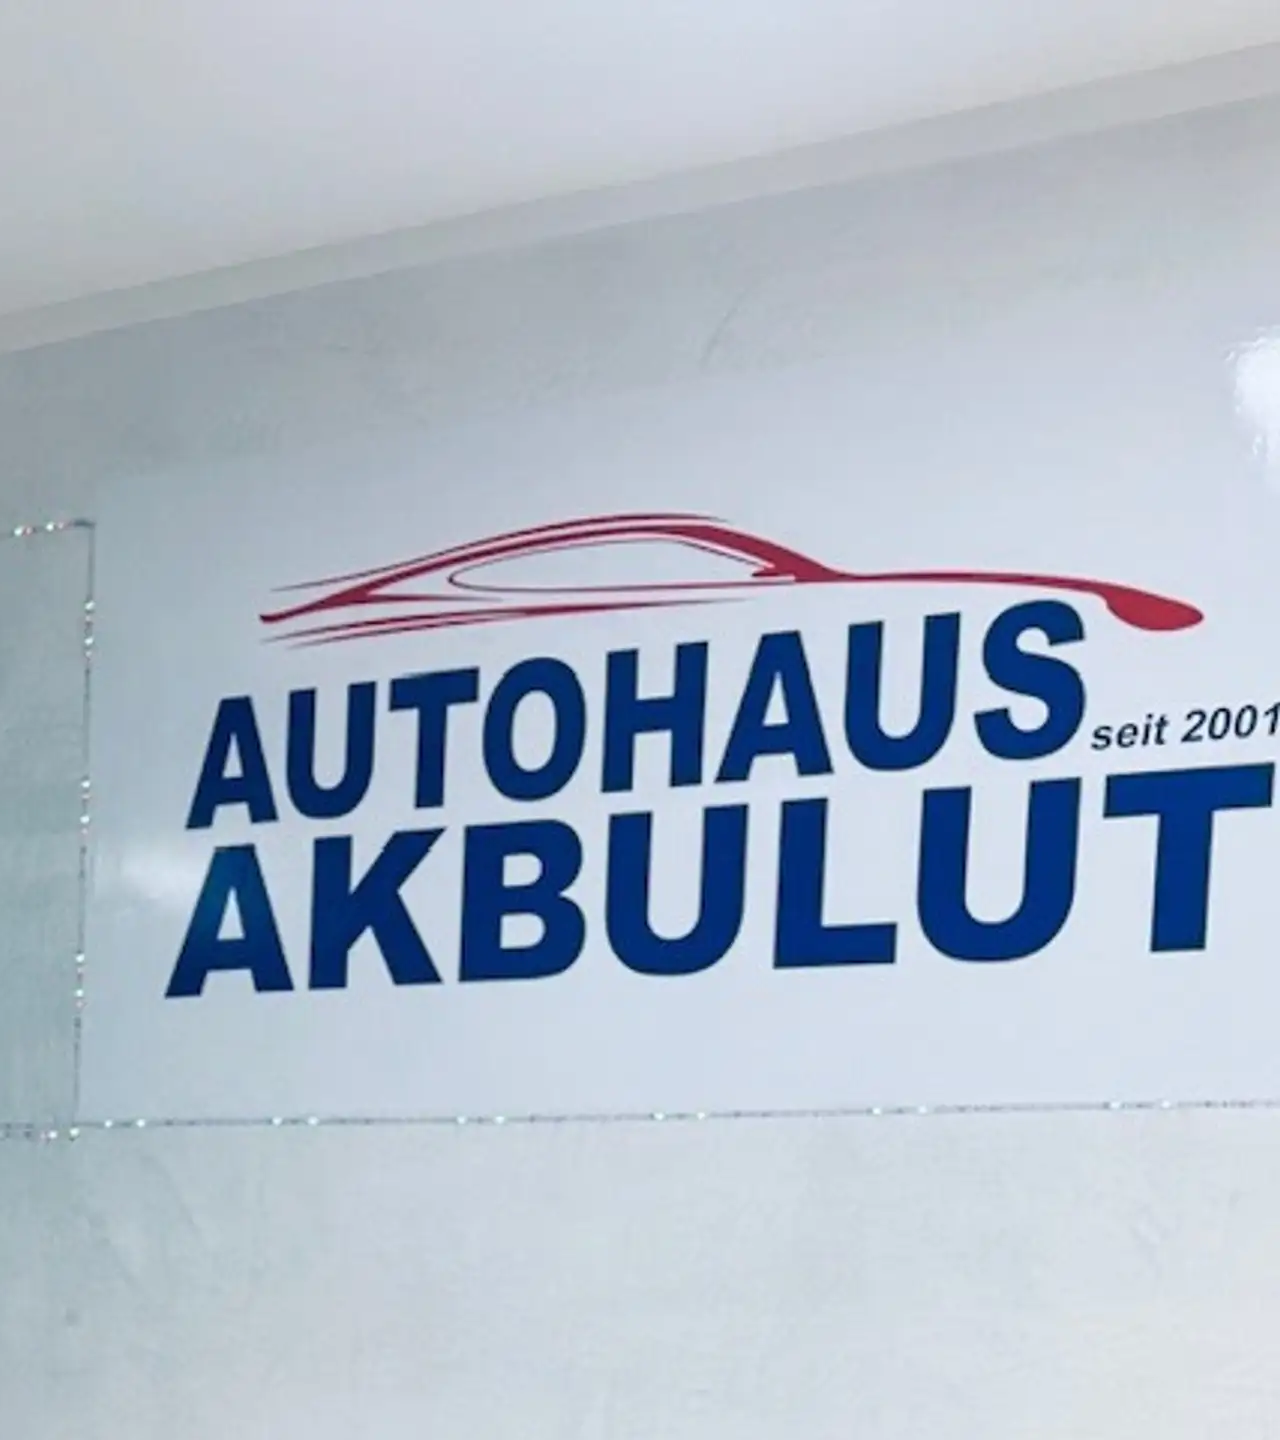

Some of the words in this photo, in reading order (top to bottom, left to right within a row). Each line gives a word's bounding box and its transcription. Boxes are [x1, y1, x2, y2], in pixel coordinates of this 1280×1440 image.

[185, 599, 1087, 830] AUTOHAUS
[1090, 712, 1170, 752] seit
[1180, 702, 1280, 744] 2001
[164, 762, 1276, 999] AKBULUT
